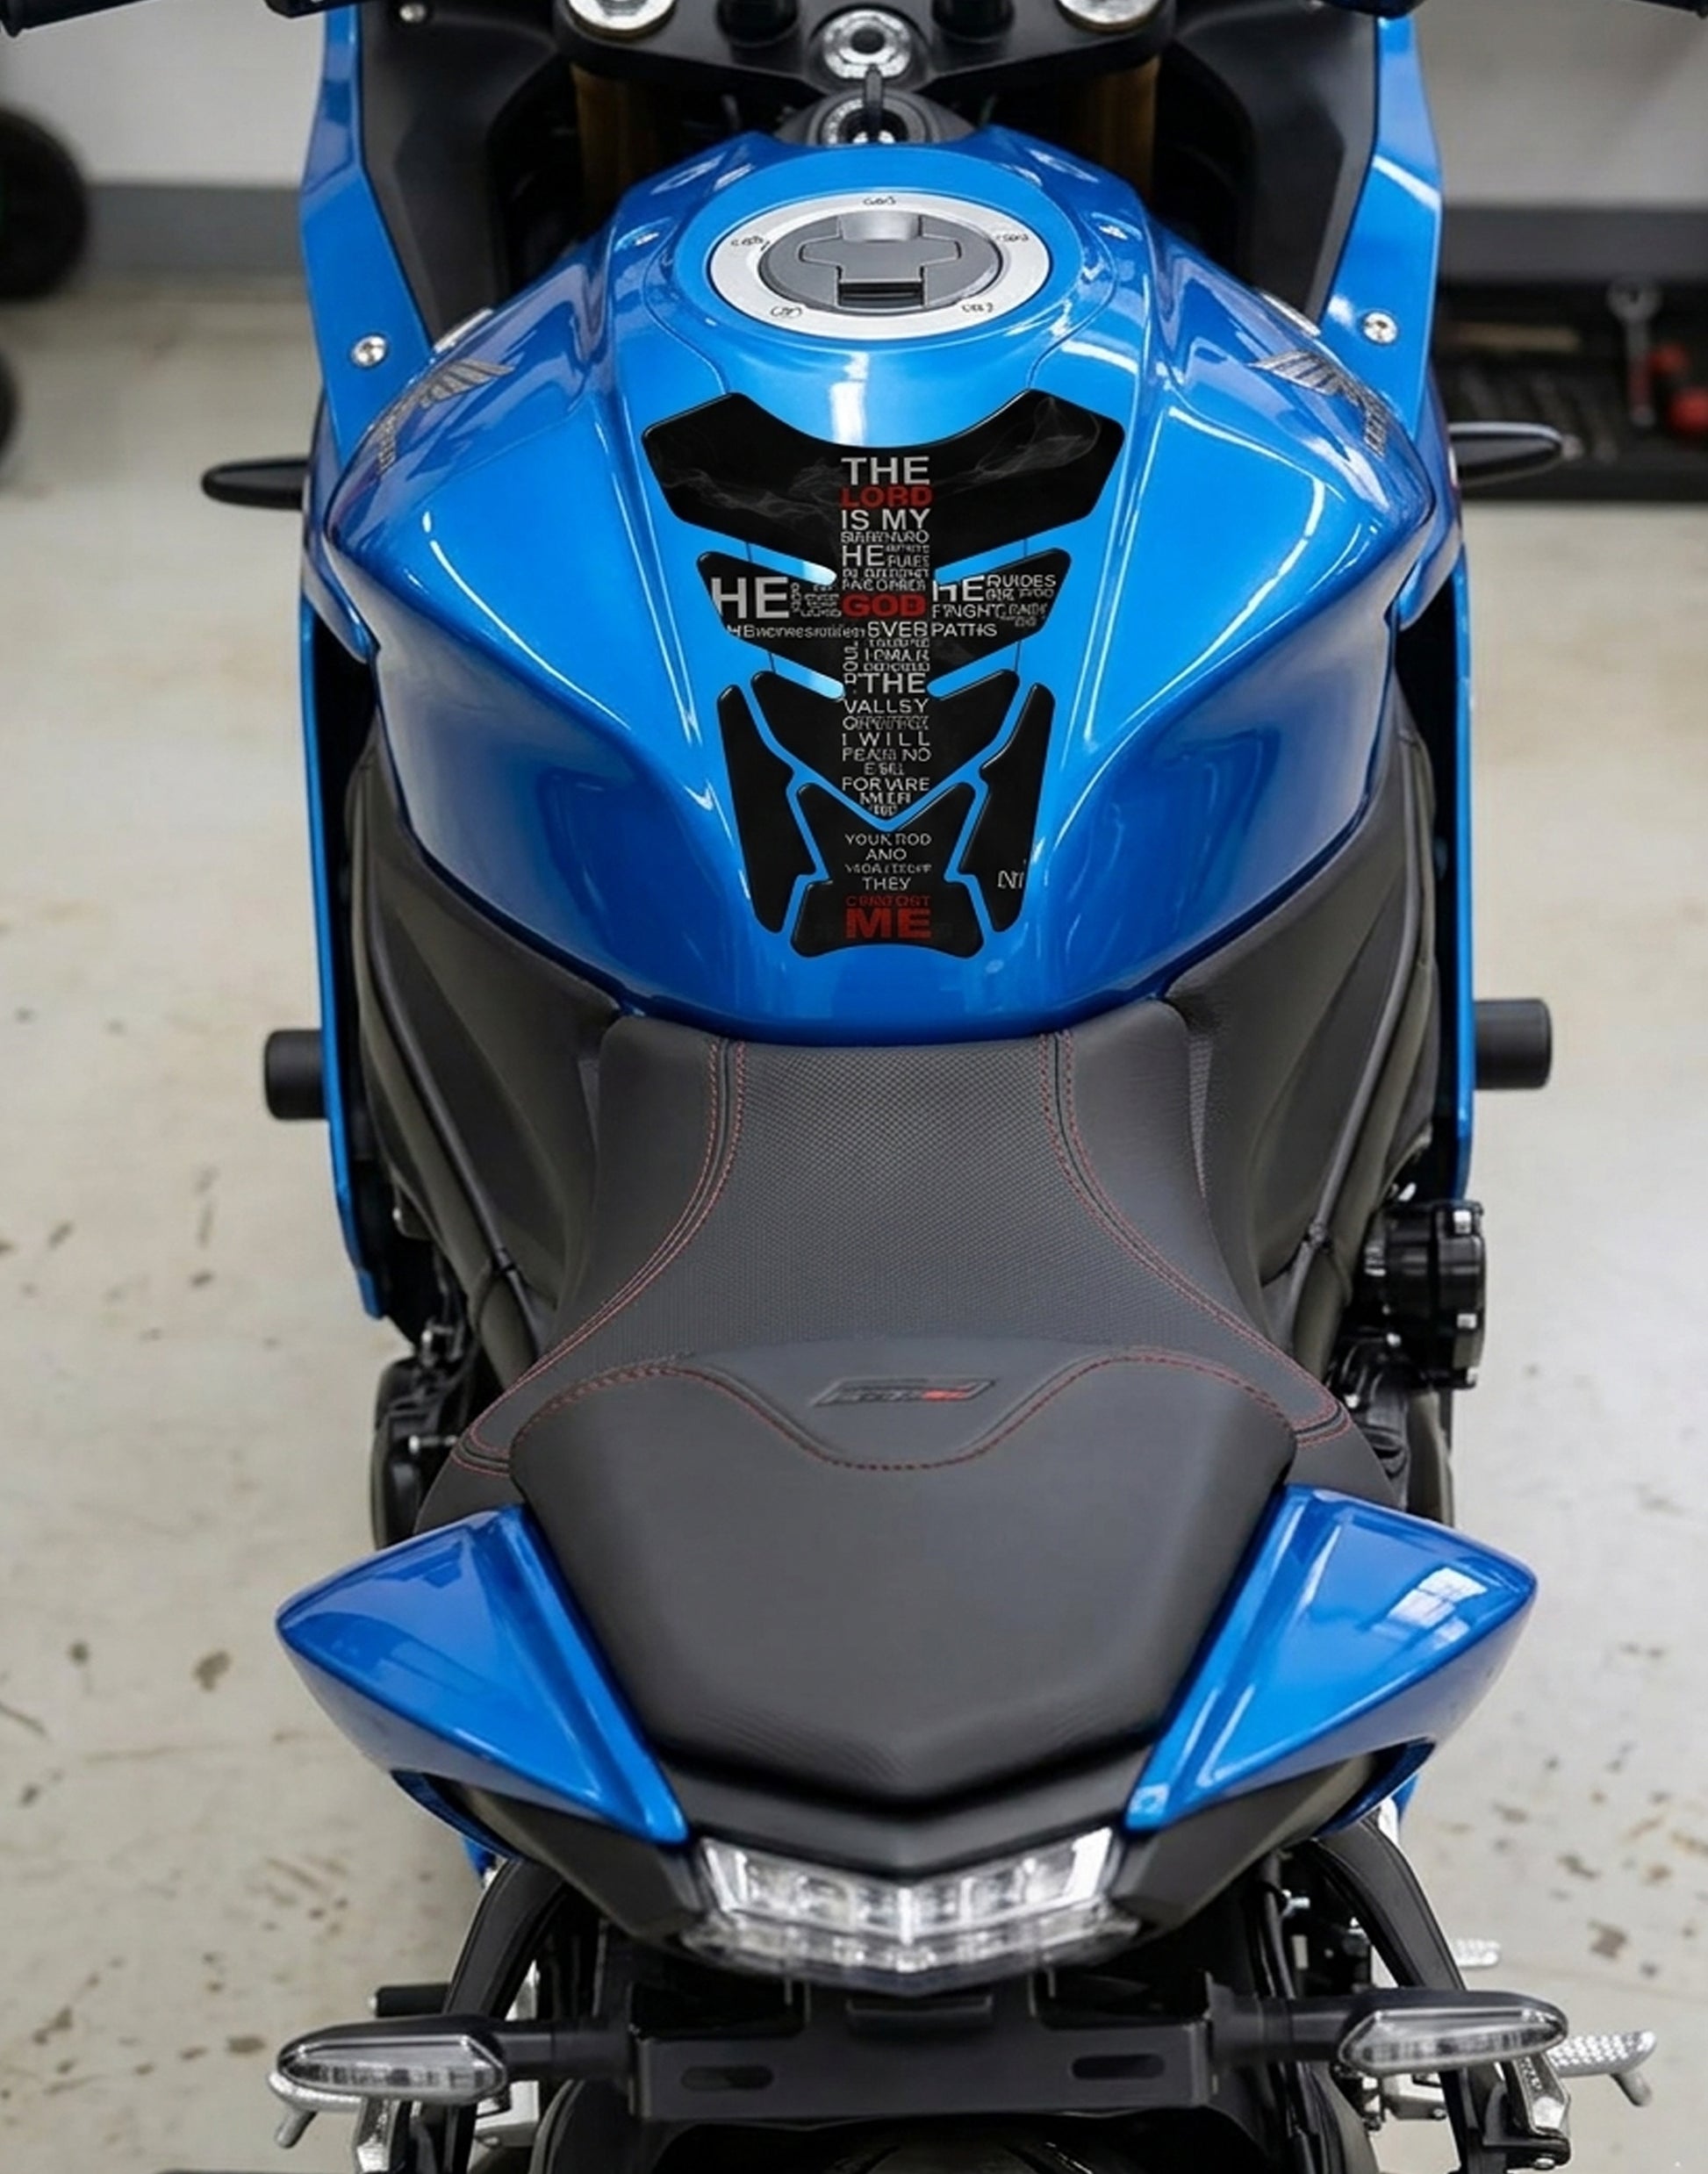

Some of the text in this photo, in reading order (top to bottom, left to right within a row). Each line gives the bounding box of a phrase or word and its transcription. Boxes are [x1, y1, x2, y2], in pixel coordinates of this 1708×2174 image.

[841, 456, 930, 485] THE
[840, 485, 932, 508] LORD
[842, 508, 930, 531] IS MY
[843, 545, 886, 567] HE
[711, 577, 790, 619] HE
[932, 576, 986, 602] HE
[843, 594, 927, 617] GOD
[858, 672, 926, 693] THE
[858, 731, 930, 746] WILL
[845, 907, 932, 939] ME
